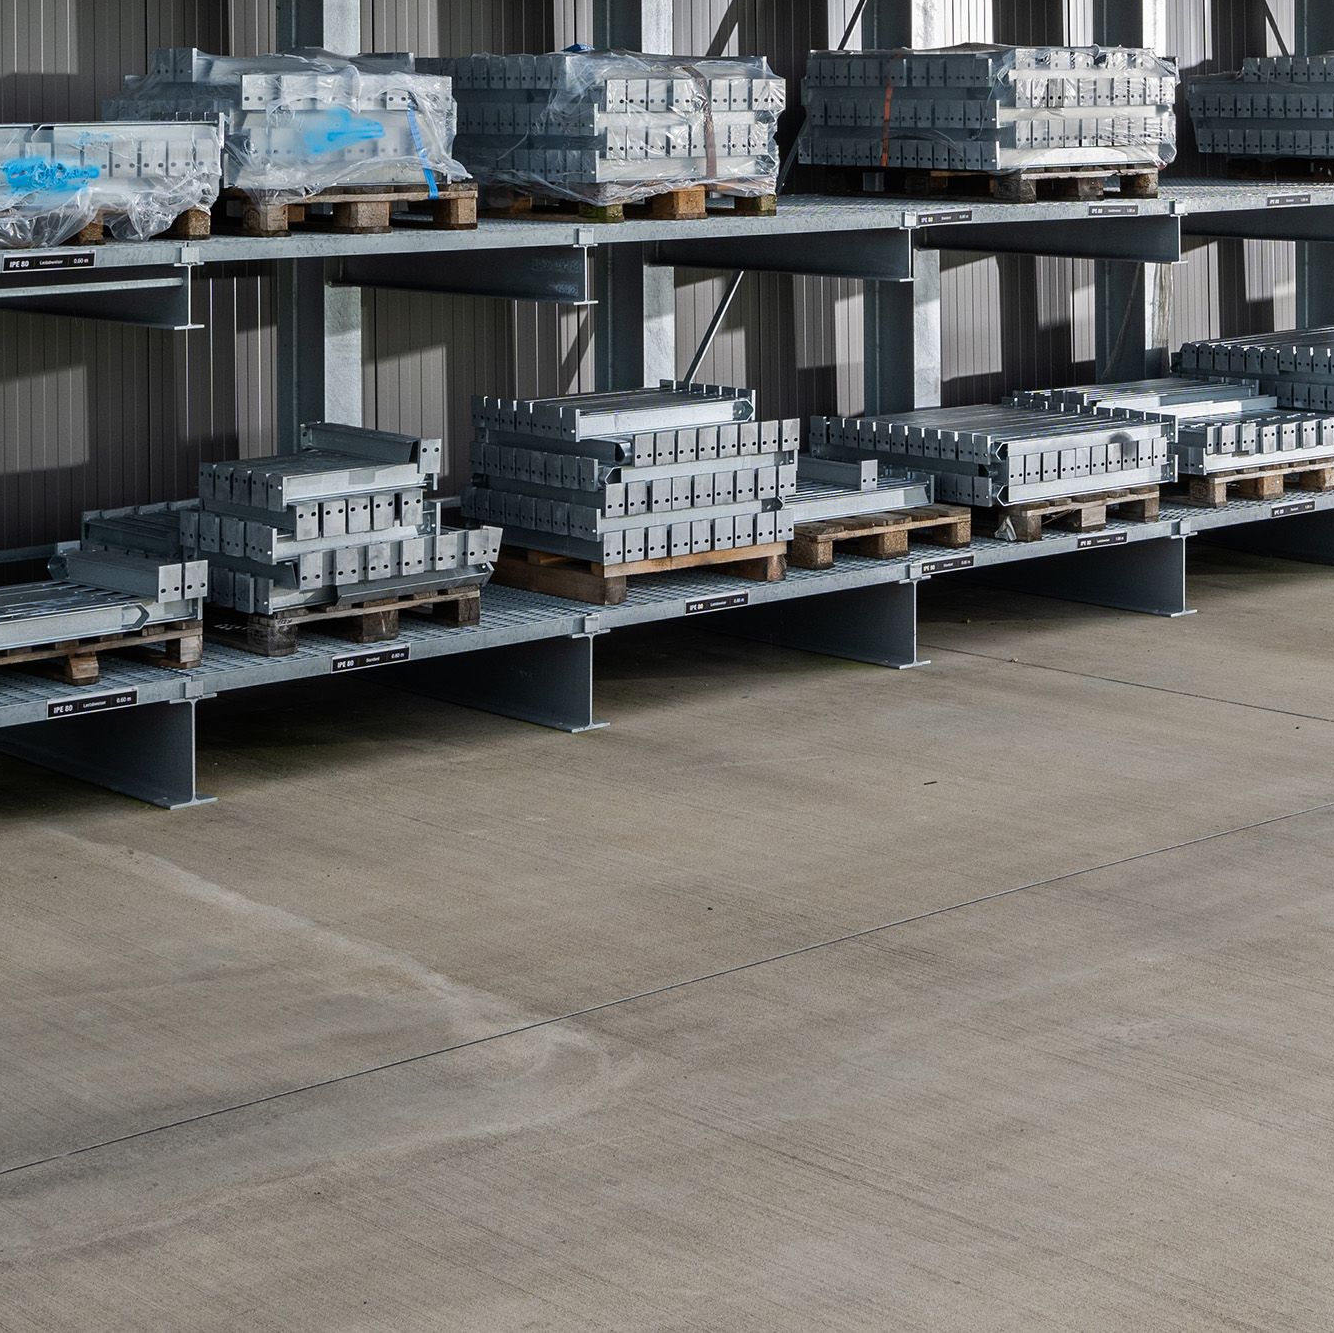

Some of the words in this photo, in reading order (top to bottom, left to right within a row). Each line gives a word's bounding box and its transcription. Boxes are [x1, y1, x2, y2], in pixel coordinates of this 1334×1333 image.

[20, 260, 30, 268] 80
[337, 660, 347, 669] IPE
[346, 659, 355, 667] 80
[53, 705, 64, 714] IPE
[64, 704, 73, 712] 80
